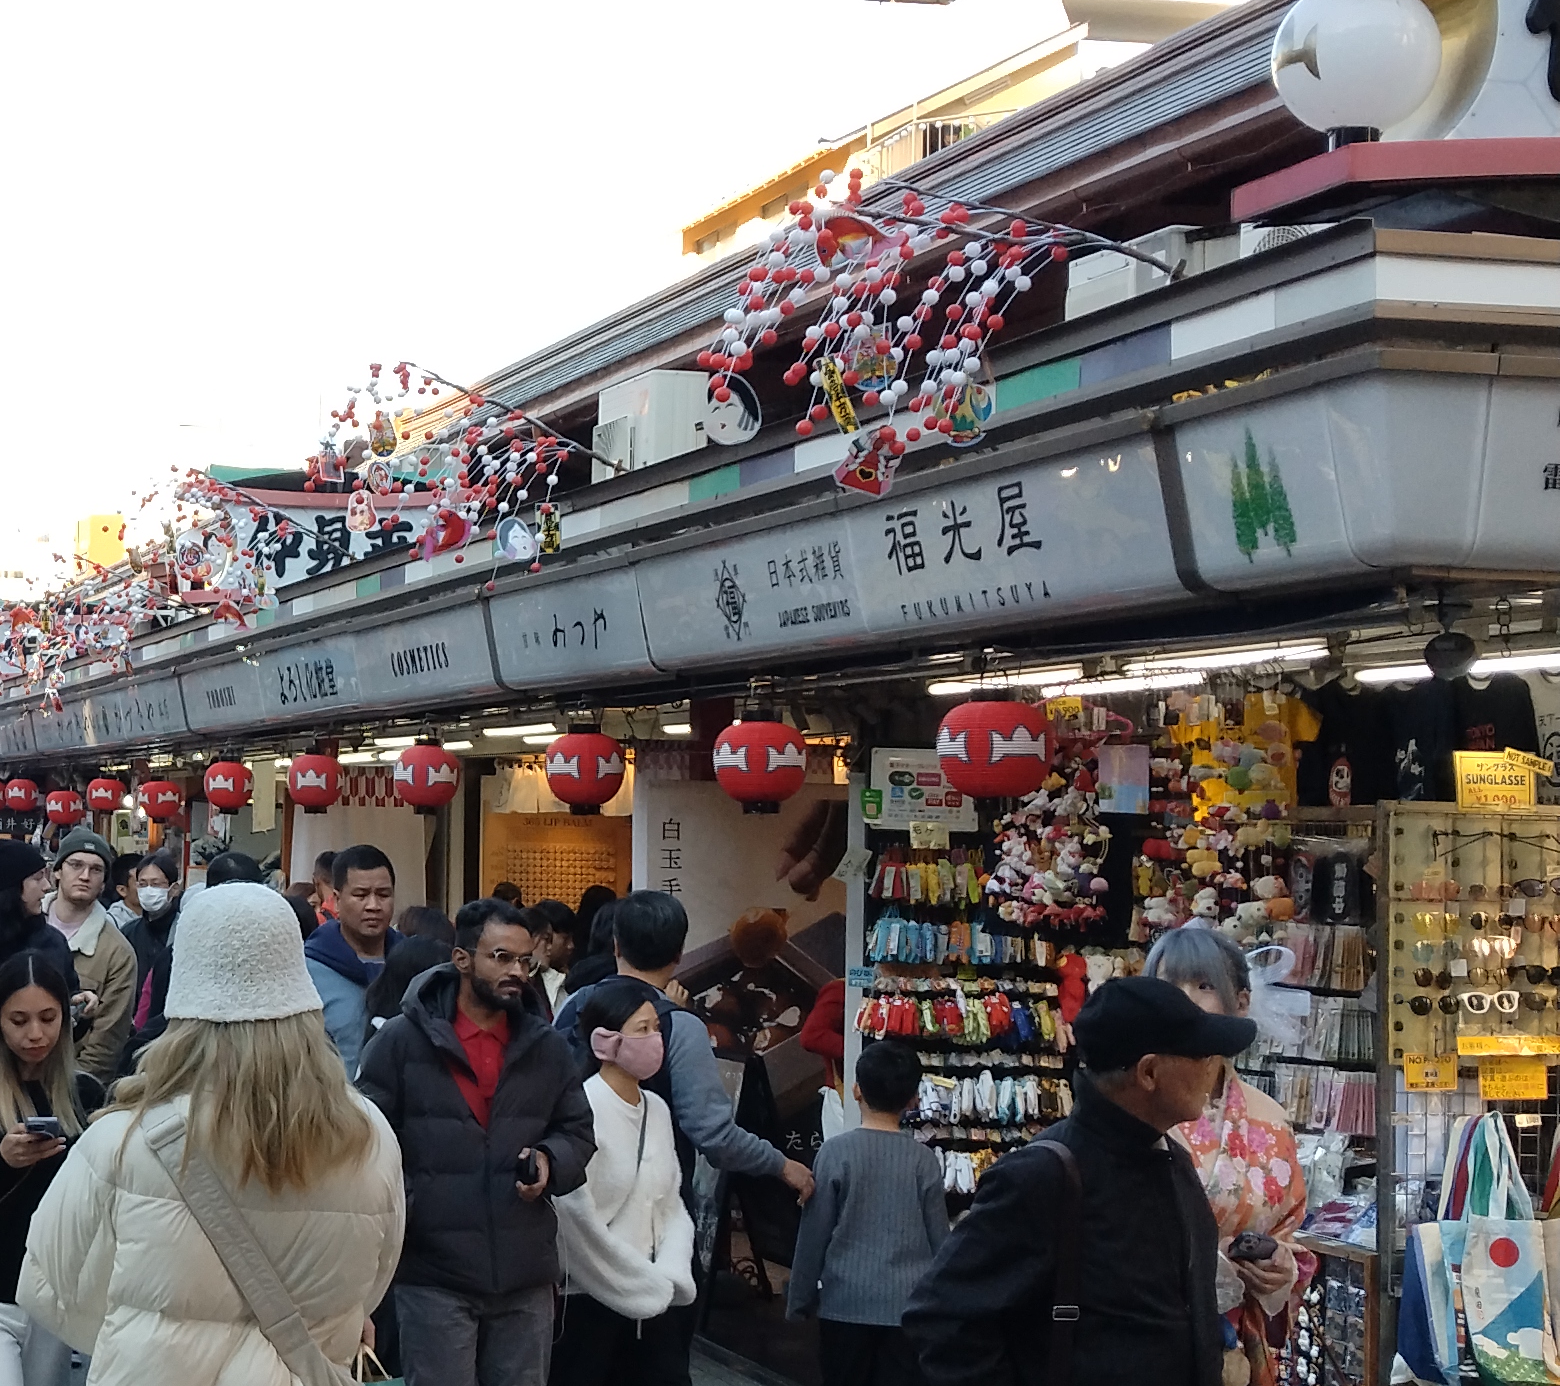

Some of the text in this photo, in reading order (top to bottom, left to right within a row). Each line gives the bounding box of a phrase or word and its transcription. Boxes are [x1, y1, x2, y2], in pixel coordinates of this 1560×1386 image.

[884, 480, 1043, 576] 福光屋
[900, 580, 1052, 622] FUKUMITSUYA
[551, 606, 607, 650] みつや
[390, 641, 450, 678] COSMETICS
[543, 817, 561, 826] LIP
